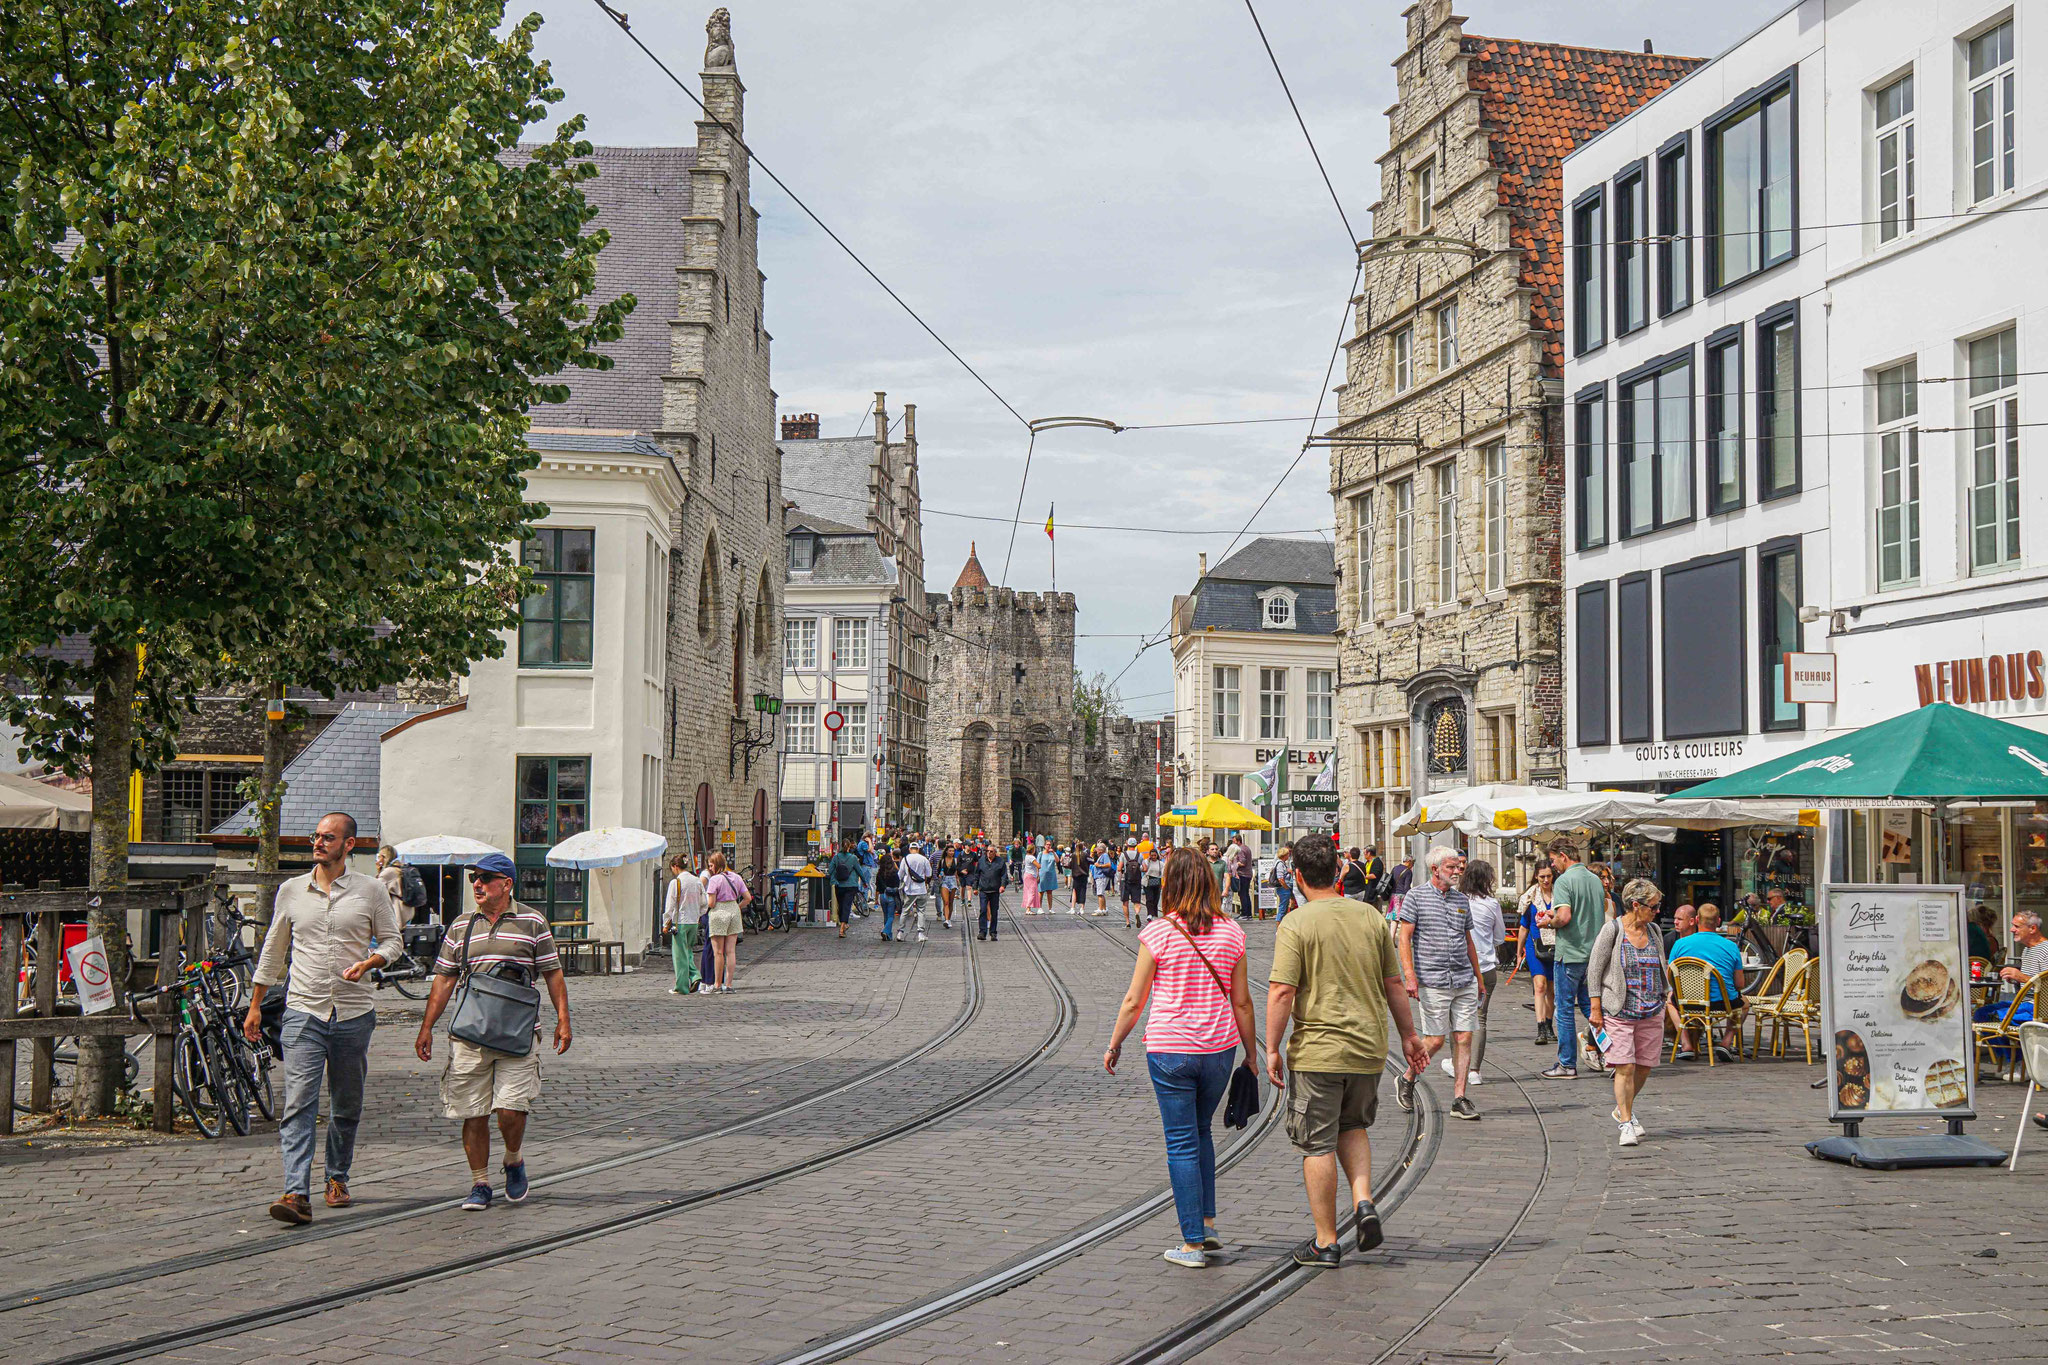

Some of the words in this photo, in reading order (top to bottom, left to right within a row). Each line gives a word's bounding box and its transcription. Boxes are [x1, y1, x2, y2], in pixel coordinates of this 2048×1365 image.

[1794, 670, 1831, 682] NEUHAUS
[1914, 650, 2045, 708] NEUHAUS
[1635, 743, 1669, 761] GOÛTS
[1673, 745, 1681, 759] &
[1685, 740, 1744, 758] COULEURS
[1293, 794, 1317, 803] BOAT
[1319, 794, 1339, 803] TRIP
[1849, 950, 1870, 963] Enjoy
[1871, 950, 1887, 961] this
[1846, 963, 1864, 972] Ghent
[1864, 964, 1890, 974] speciality
[1852, 1009, 1871, 1020] Taste
[1893, 1061, 1902, 1070] Or
[1907, 1066, 1919, 1074] real
[1894, 1072, 1915, 1083] Belgian
[1898, 1084, 1918, 1095] Waffle
